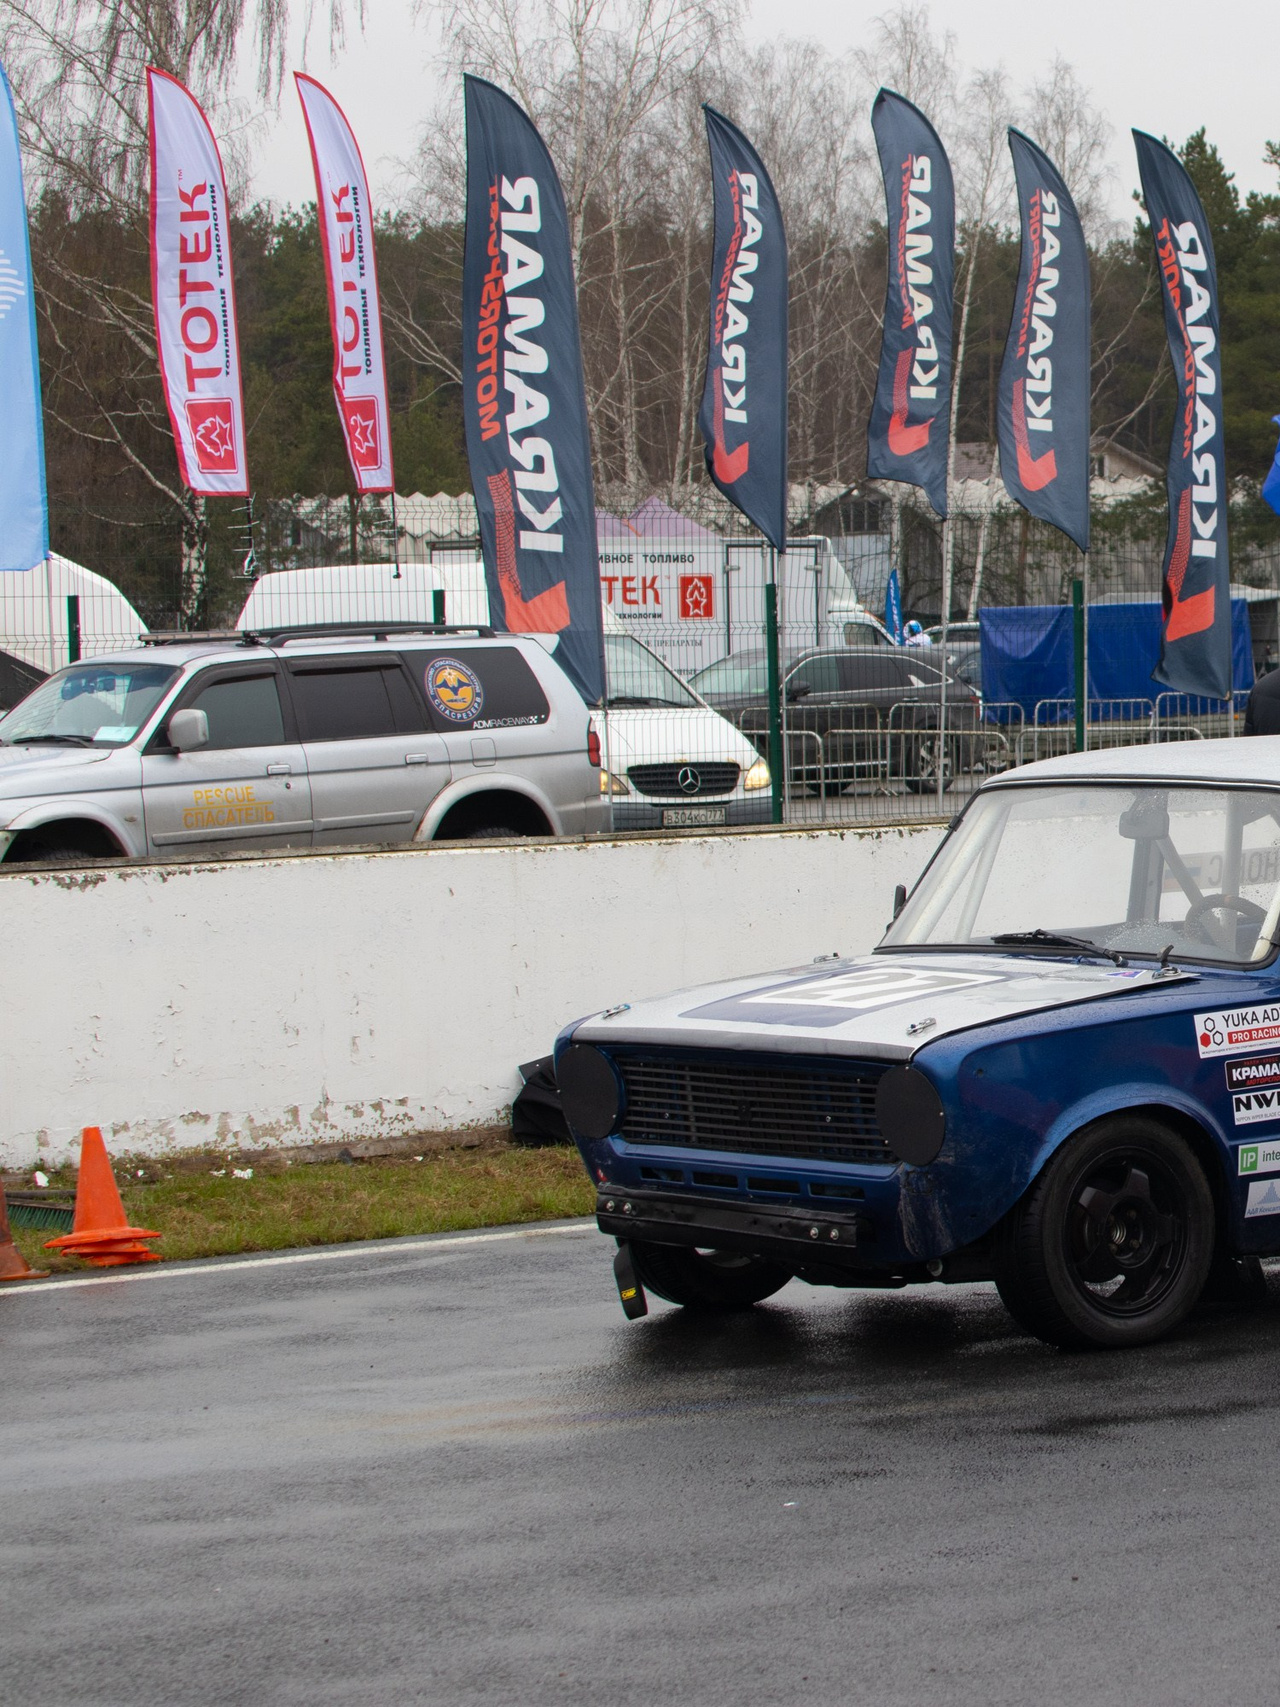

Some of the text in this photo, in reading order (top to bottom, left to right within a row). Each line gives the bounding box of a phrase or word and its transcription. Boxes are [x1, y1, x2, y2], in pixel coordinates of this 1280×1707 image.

[209, 184, 230, 377] ТОПЛИВНЫЕ ТЕХНОЛОГИИ
[351, 186, 372, 376] ТОПЛИВНЫЕ ТЕХНОЛОГИИ
[642, 554, 695, 564] ТОПЛИВО
[434, 697, 481, 720] СПАСРЕЗЕРВ
[183, 806, 274, 829] СПАСАТЕЛЬ
[1222, 1010, 1260, 1028] YUKA
[1231, 1032, 1250, 1043] PRO
[1242, 1152, 1256, 1168] IP
